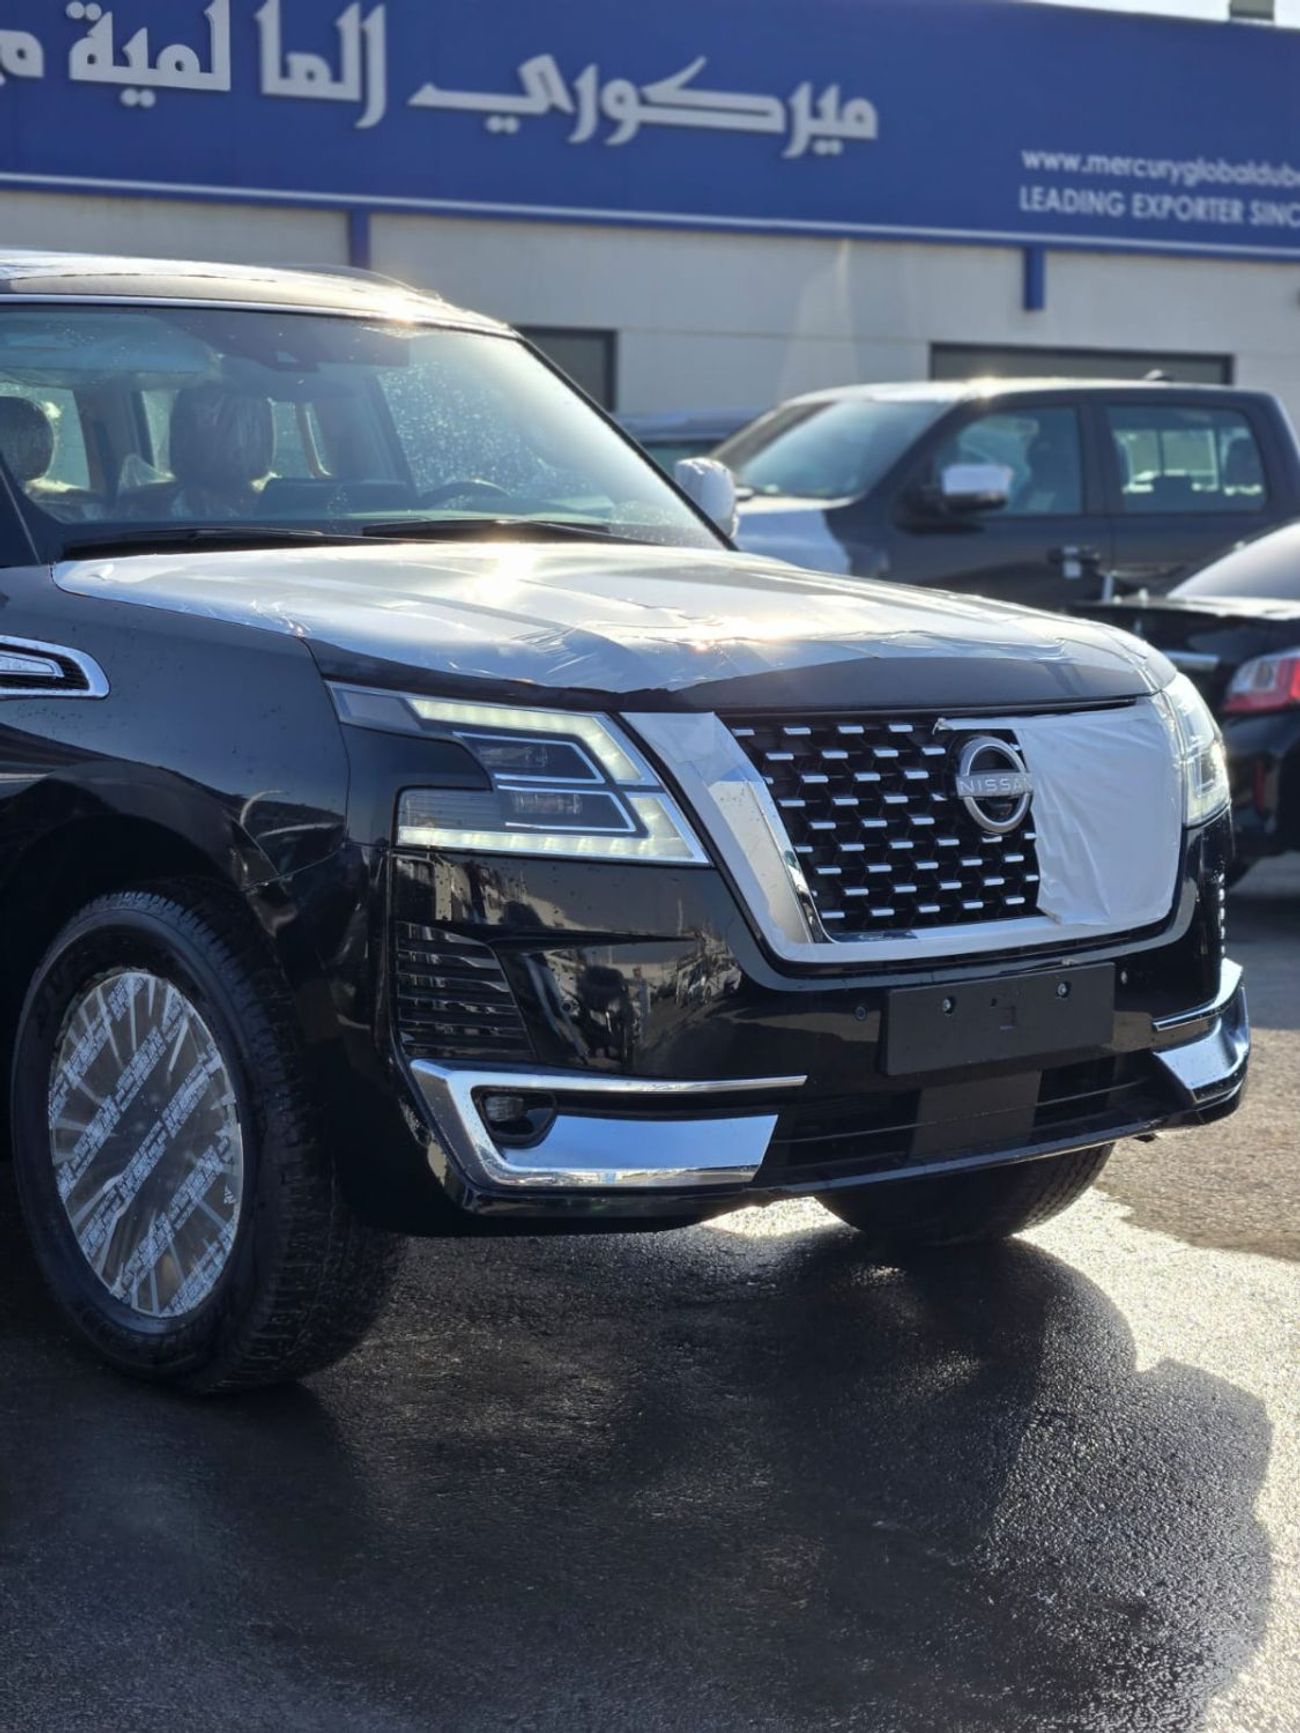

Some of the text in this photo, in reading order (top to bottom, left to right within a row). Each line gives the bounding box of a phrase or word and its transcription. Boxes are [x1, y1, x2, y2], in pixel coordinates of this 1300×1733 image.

[408, 53, 878, 158] ميركوري
[1019, 186, 1125, 217] LEADING
[1131, 194, 1243, 224] EXPORTER
